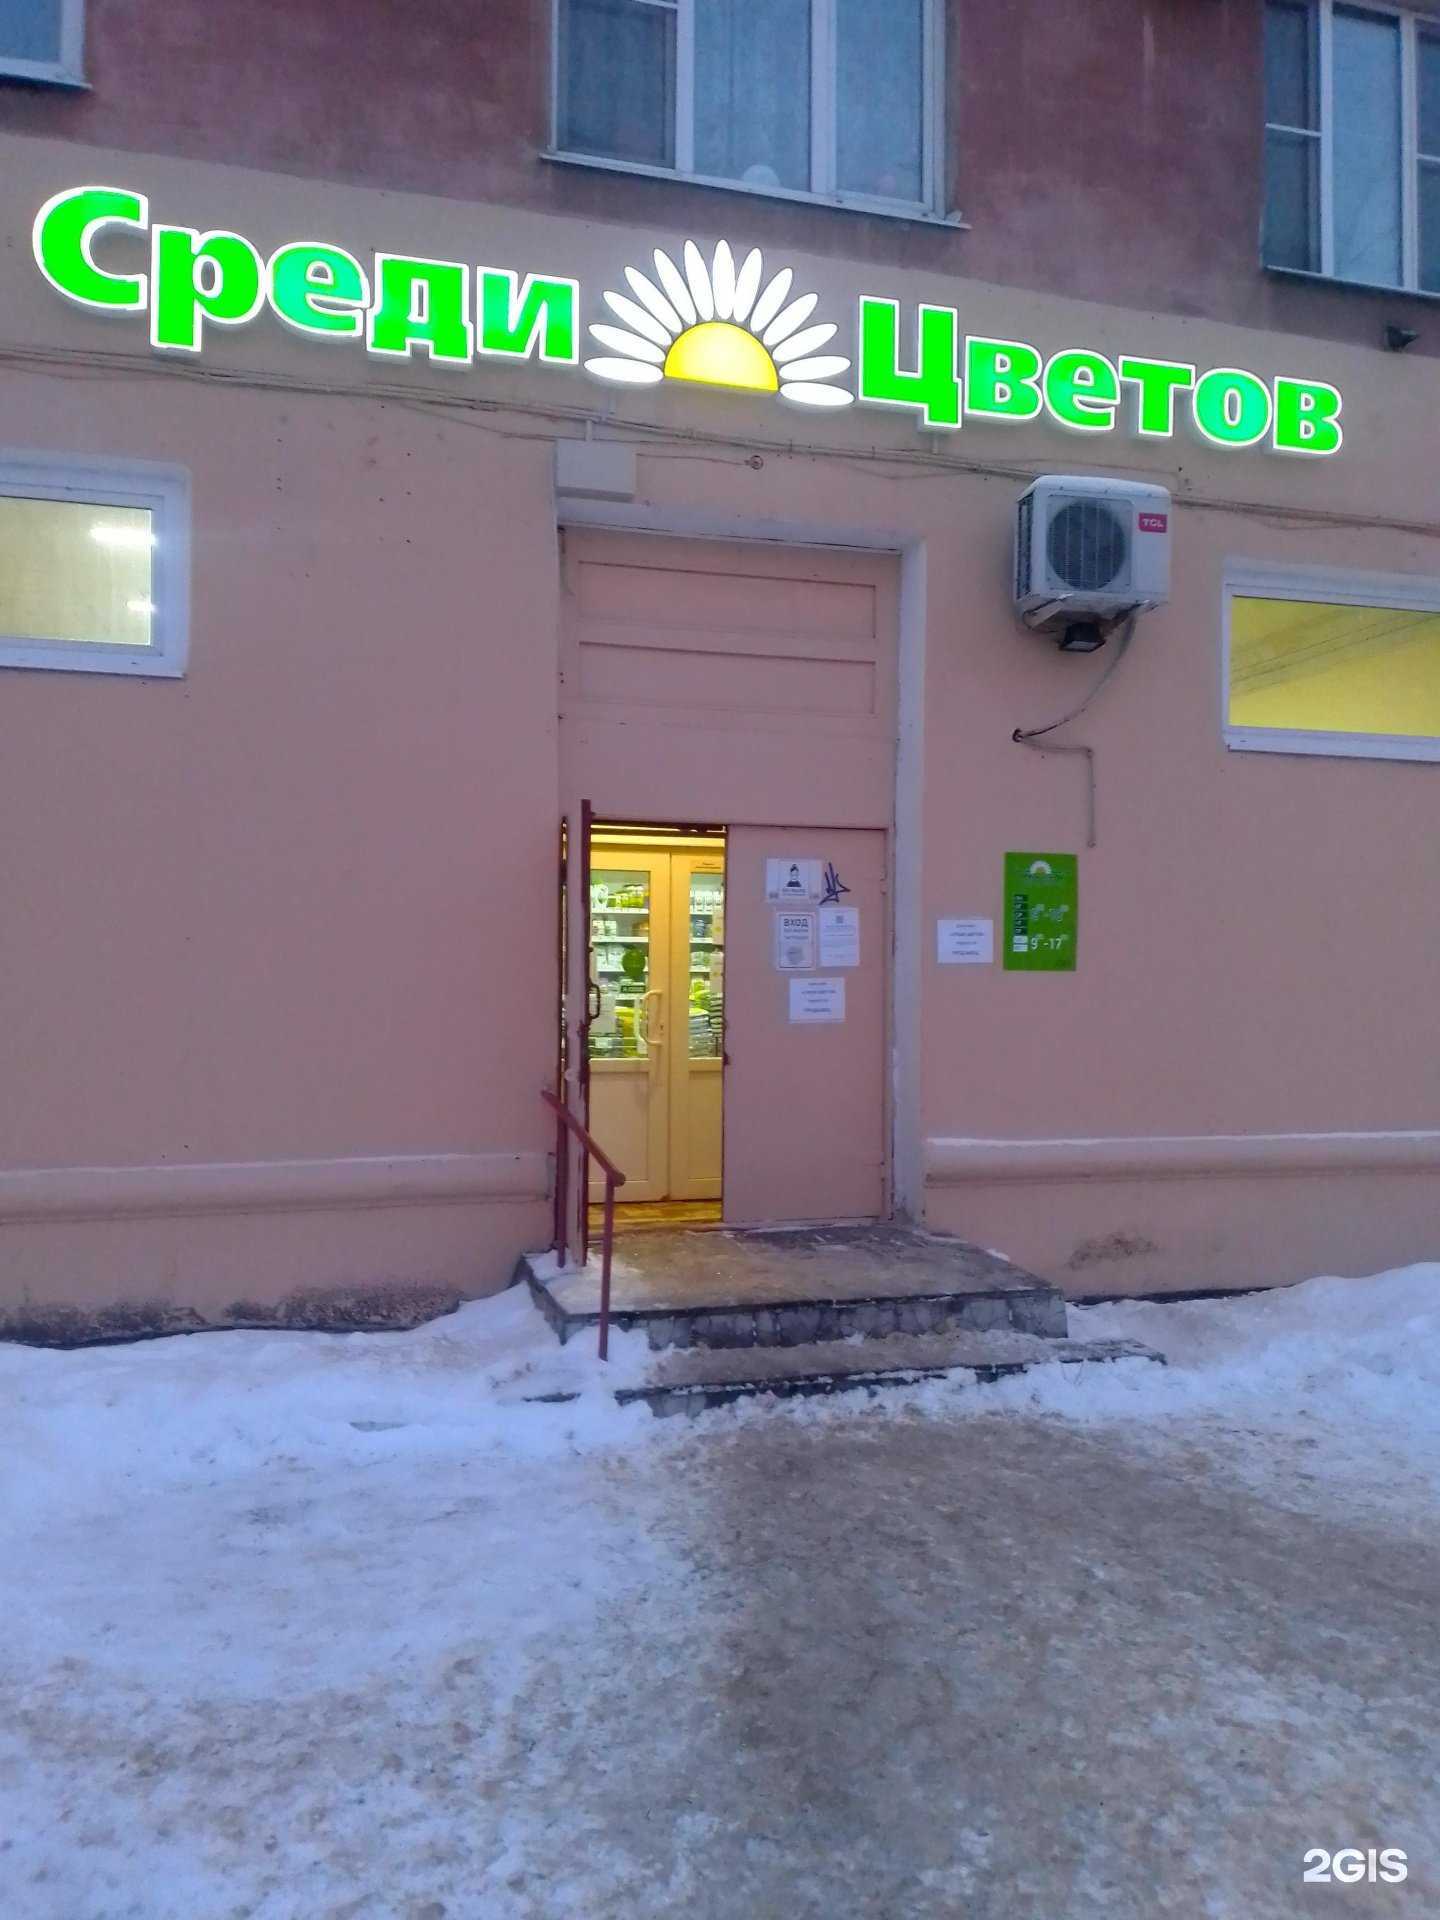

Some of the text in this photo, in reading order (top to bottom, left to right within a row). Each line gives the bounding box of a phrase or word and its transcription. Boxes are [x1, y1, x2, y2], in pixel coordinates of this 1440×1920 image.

[33, 186, 1343, 454] Среди Цветов
[1142, 518, 1164, 528] TCL
[783, 918, 809, 929] ВХОД
